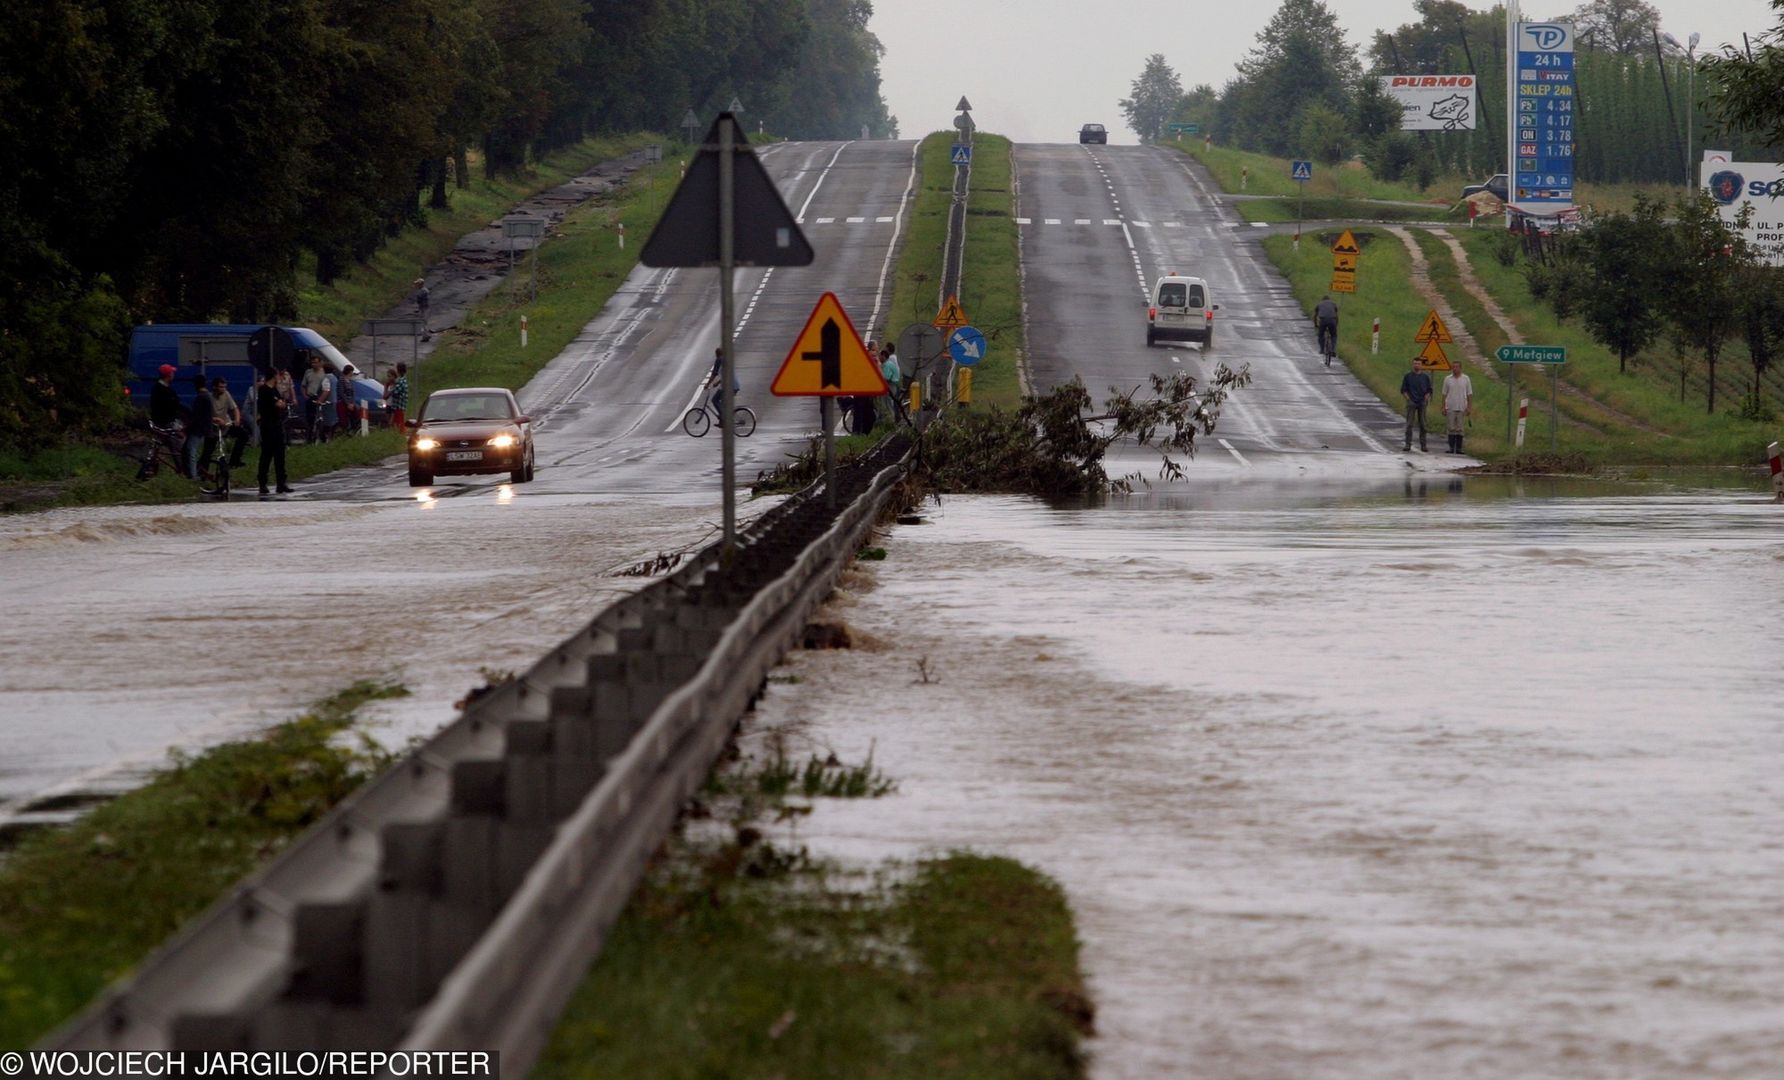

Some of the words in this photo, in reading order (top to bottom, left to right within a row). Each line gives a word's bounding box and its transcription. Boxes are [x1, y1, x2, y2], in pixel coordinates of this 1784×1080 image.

[1535, 54, 1549, 66] 24
[1553, 55, 1561, 66] h
[1540, 70, 1569, 81] VITAY
[1391, 76, 1473, 88] PURMO
[1520, 84, 1551, 96] SKLEP
[1554, 85, 1572, 96] 24h
[1547, 100, 1571, 111] 4.34
[1547, 115, 1571, 126] 4.17
[1522, 130, 1535, 140] ON
[1547, 130, 1571, 141] 3.78
[1520, 145, 1537, 155] GAZ
[1547, 145, 1571, 156] 1.76
[1757, 222, 1774, 230] UL.
[1503, 349, 1510, 359] 9
